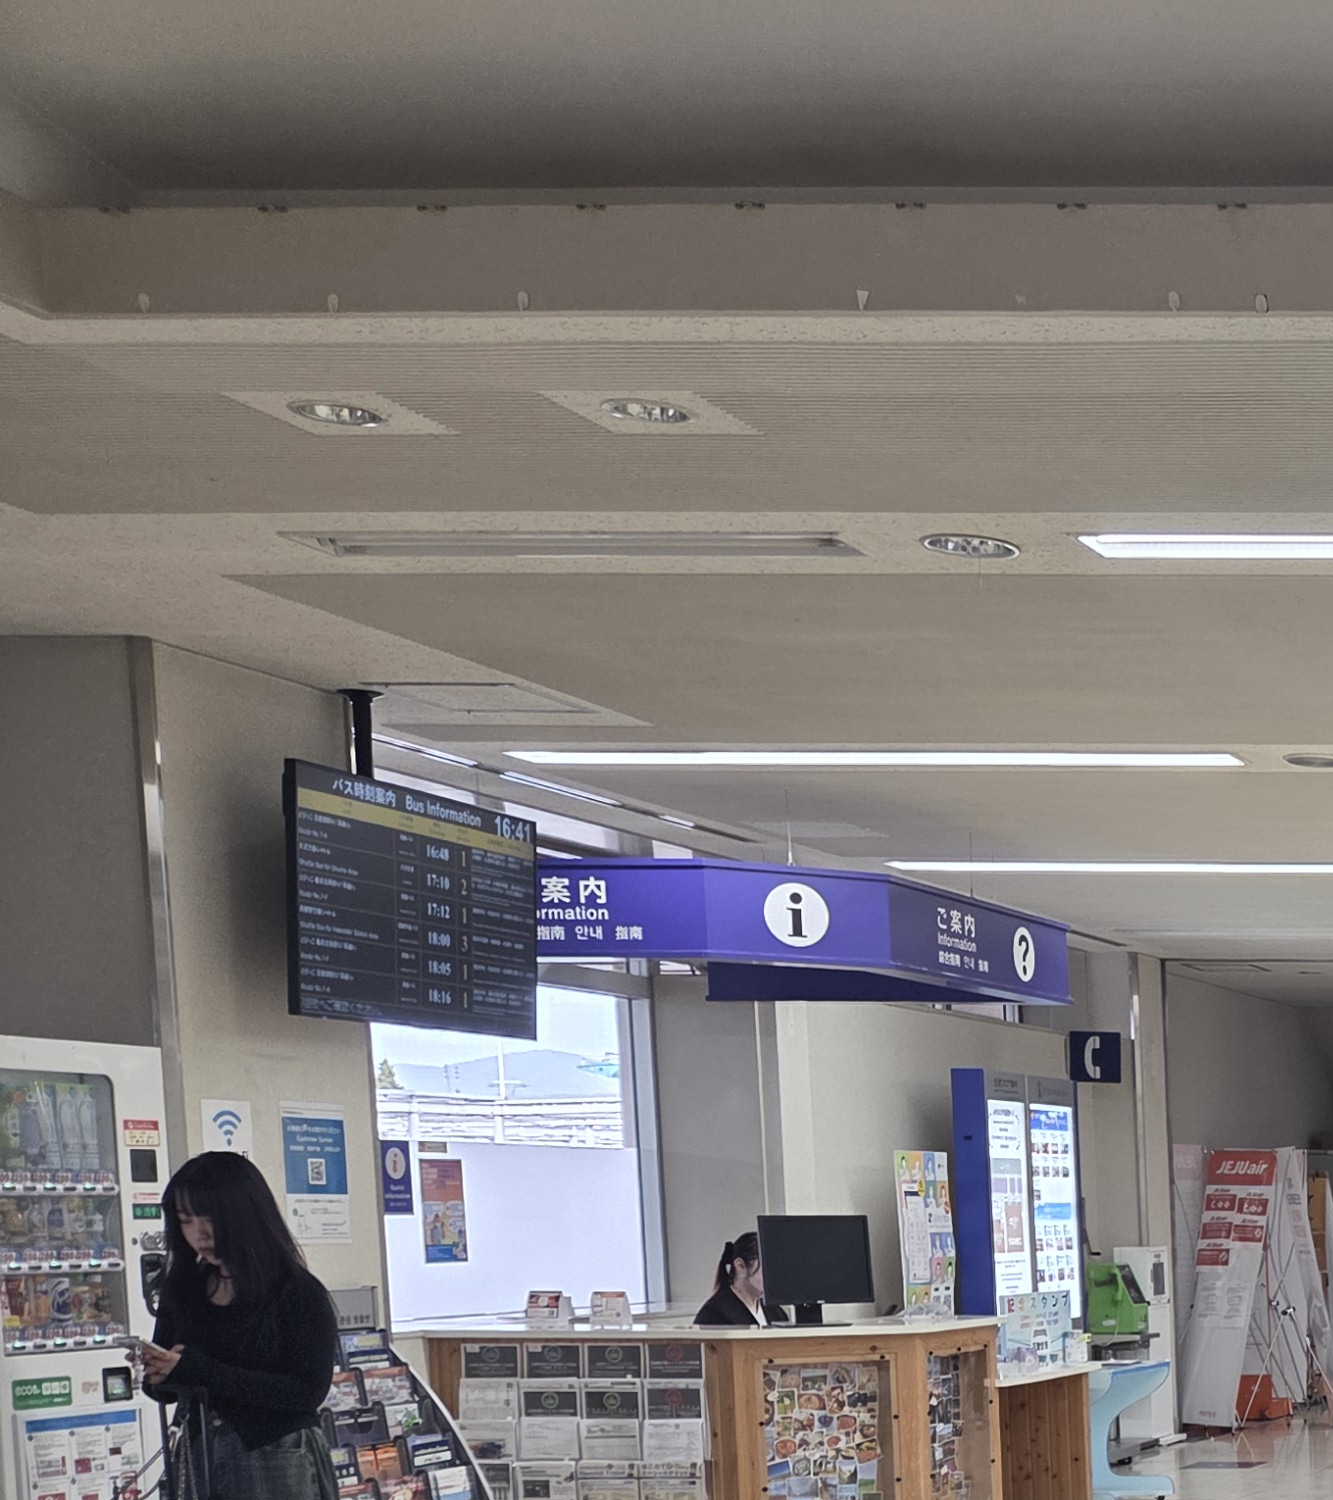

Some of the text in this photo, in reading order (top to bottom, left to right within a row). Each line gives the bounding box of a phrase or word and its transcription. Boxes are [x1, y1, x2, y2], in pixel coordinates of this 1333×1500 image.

[405, 795, 425, 815] Bus
[427, 803, 482, 828] Information
[494, 815, 532, 844] 16:41
[540, 876, 607, 904] 案内
[428, 902, 450, 919] 17:12
[937, 907, 975, 938] ご案内
[937, 931, 977, 952] Information
